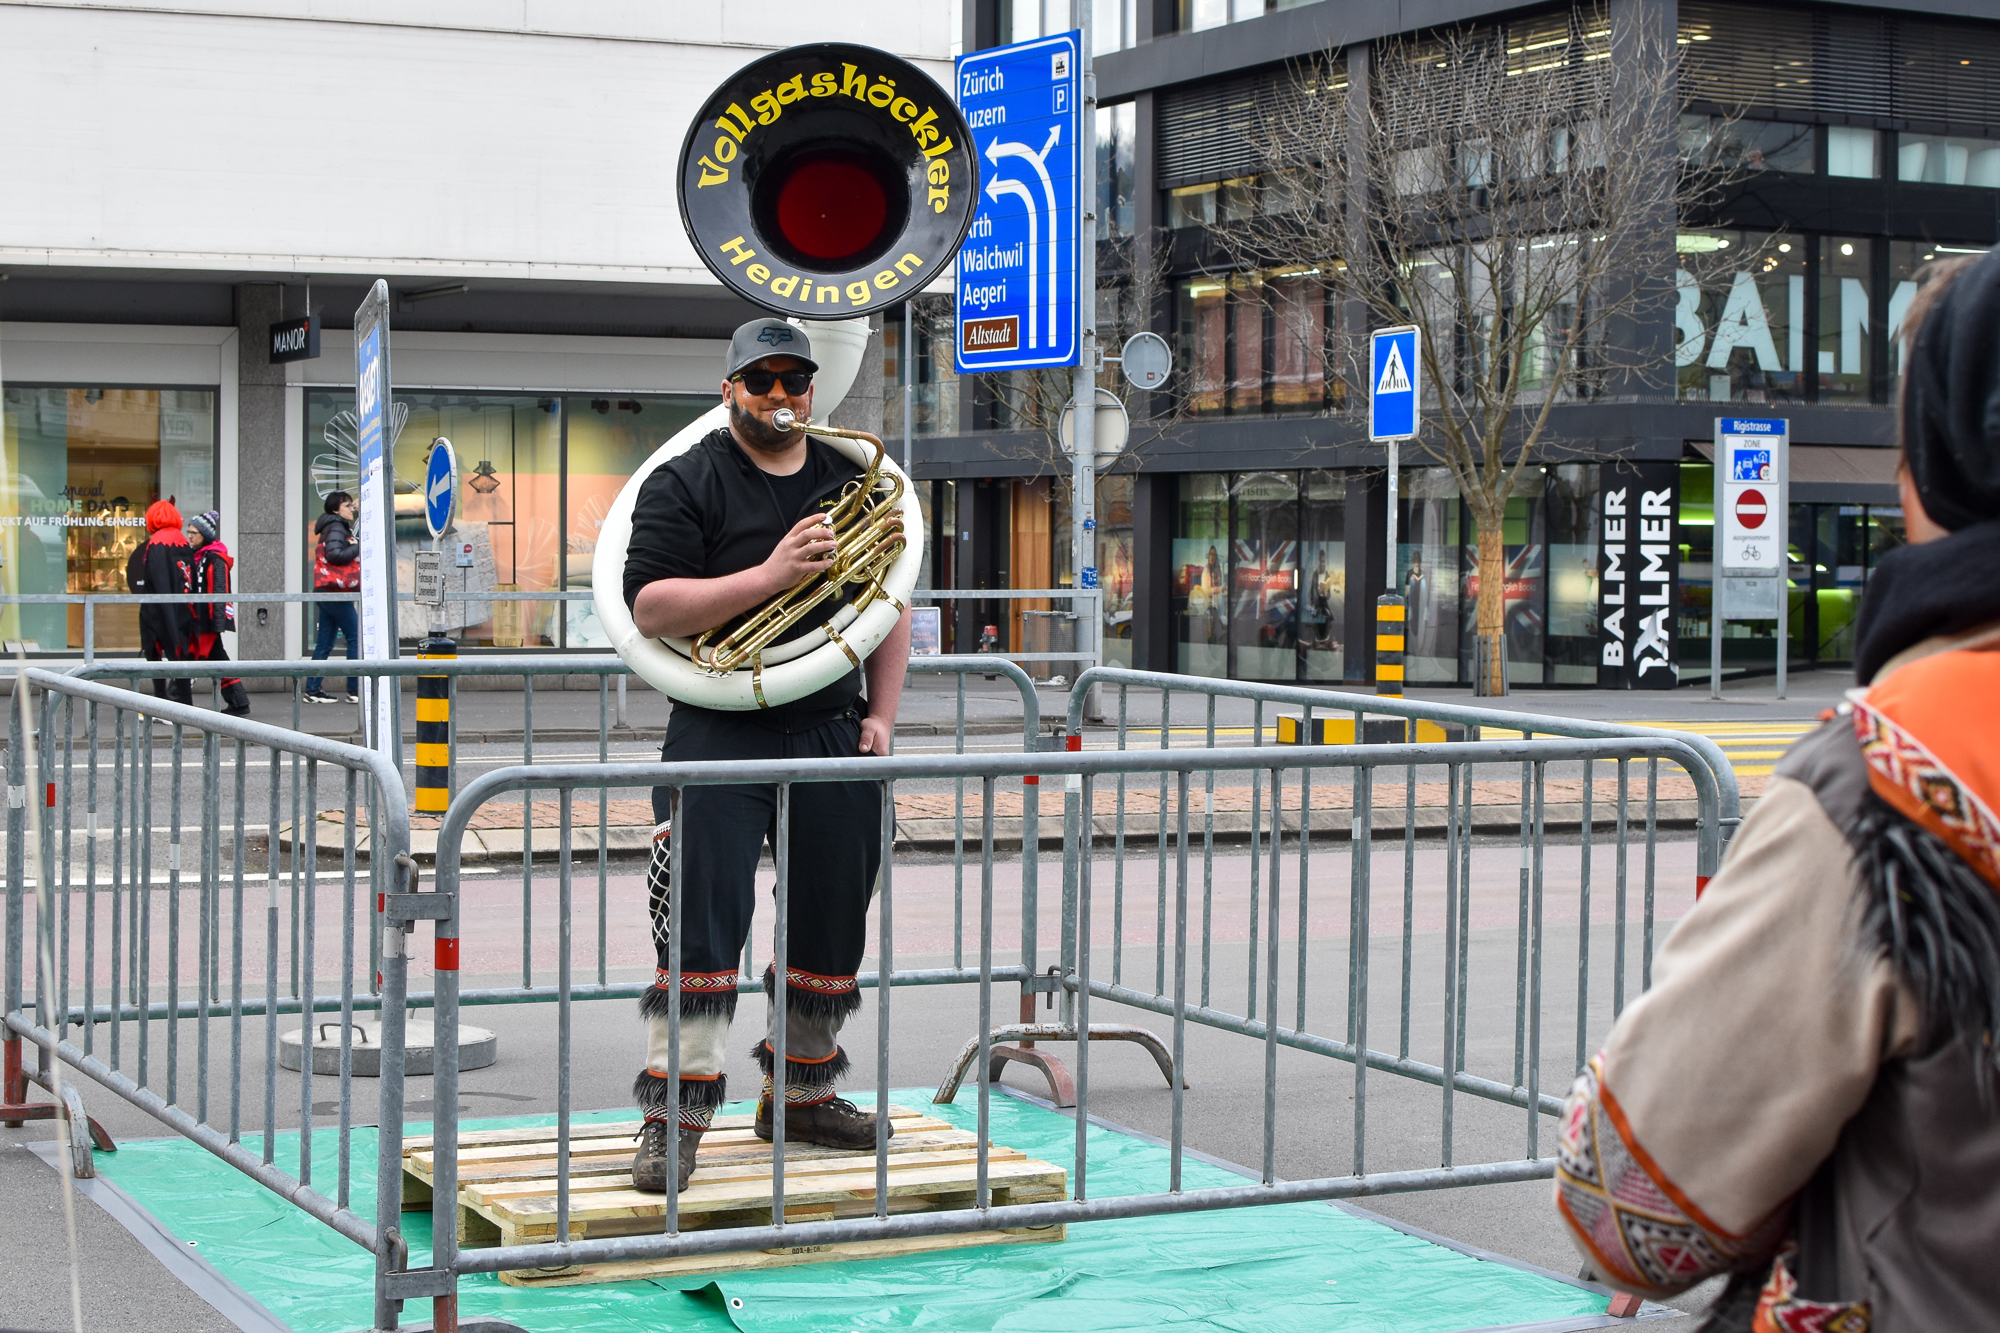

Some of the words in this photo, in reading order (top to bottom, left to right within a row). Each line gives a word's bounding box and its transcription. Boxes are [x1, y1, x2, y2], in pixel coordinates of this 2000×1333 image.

[962, 65, 1004, 97] Zürich
[1056, 89, 1065, 110] P
[697, 62, 954, 215] Vollgashöckler
[719, 234, 924, 307] Hedingen
[963, 241, 1023, 274] Walchwil
[963, 279, 1007, 312] Aegeri
[273, 327, 305, 354] MANOR
[967, 322, 1012, 346] Altstadt
[1733, 420, 1772, 434] Rigistrasse
[1743, 439, 1761, 448] ZONE
[30, 499, 83, 513] HOME
[87, 499, 130, 513] DAYS
[58, 480, 105, 506] special
[0, 516, 23, 527] EKT
[24, 516, 46, 527] AUF
[48, 514, 104, 527] FRÜHLING
[1502, 582, 1518, 593] nglish
[1602, 486, 1627, 667] BALMER
